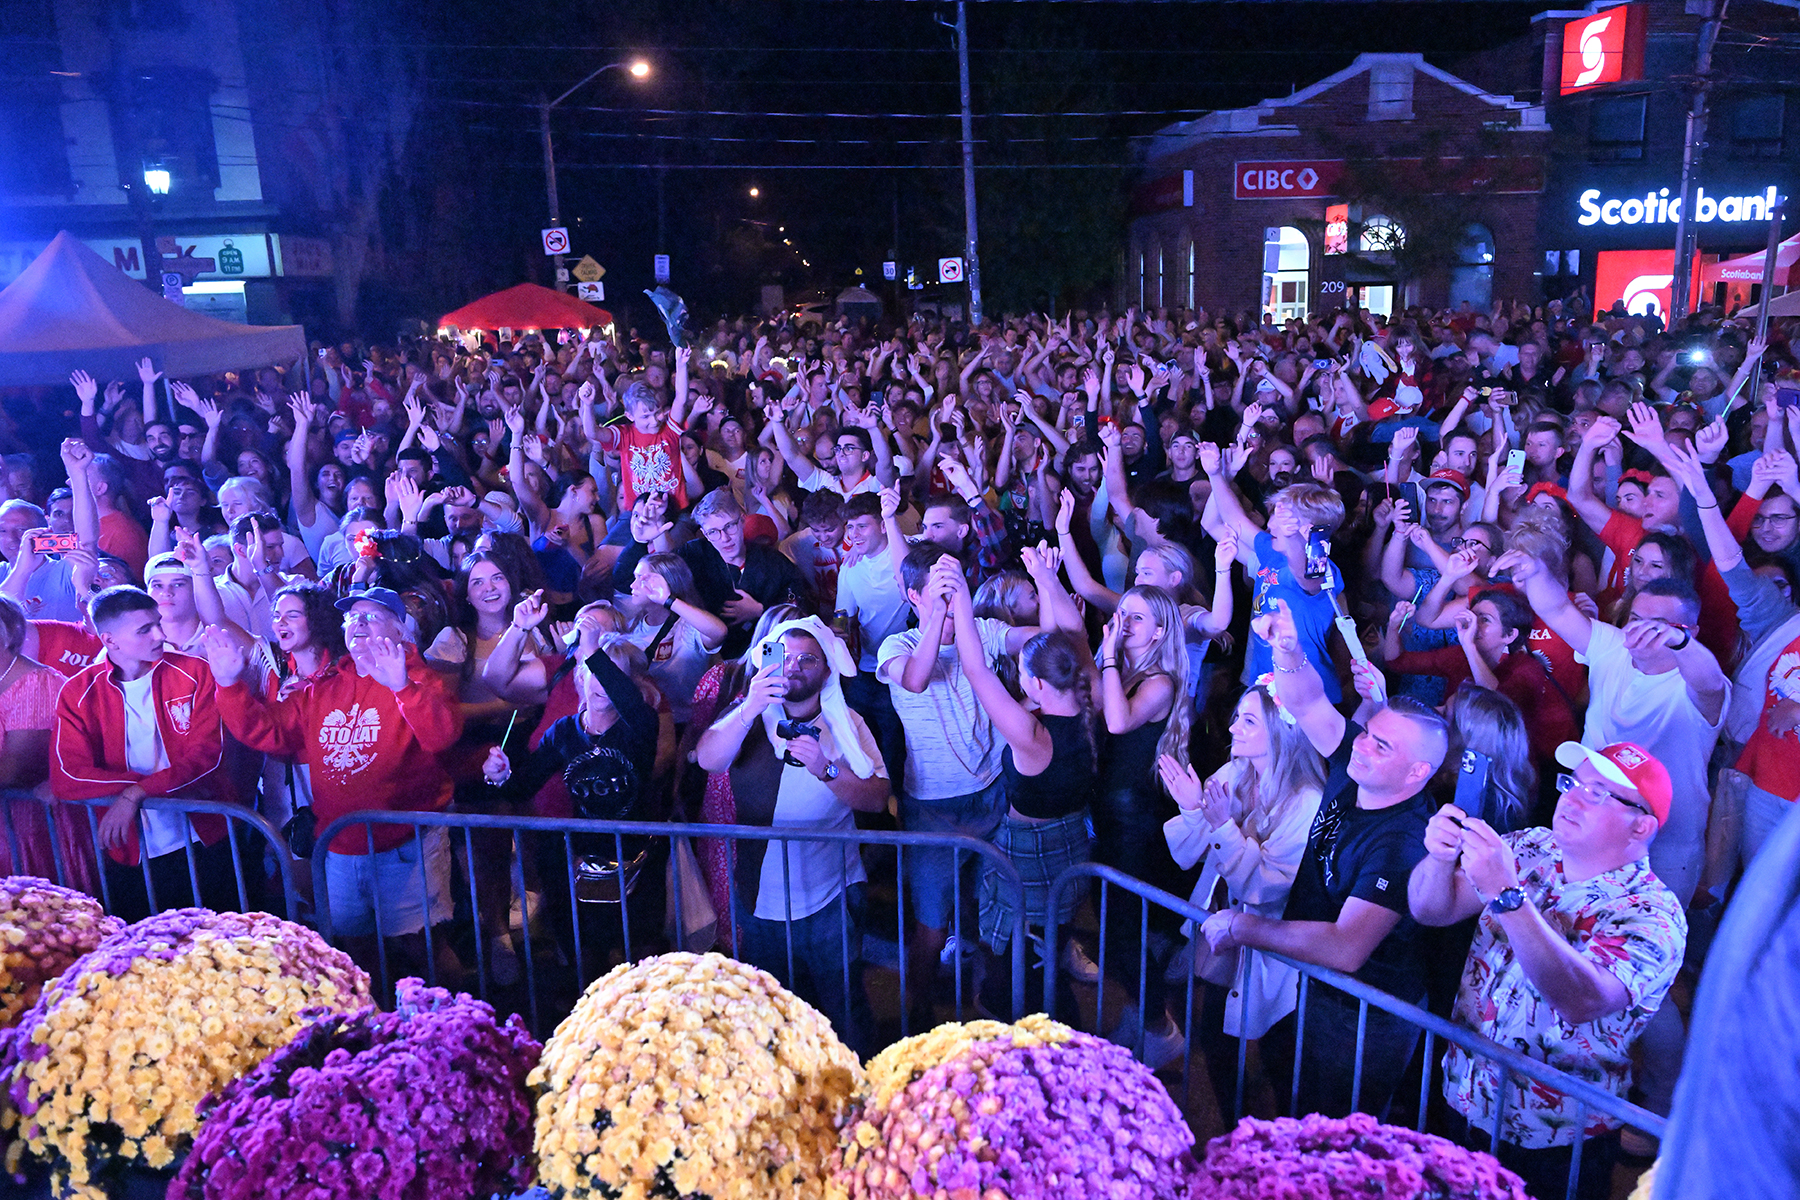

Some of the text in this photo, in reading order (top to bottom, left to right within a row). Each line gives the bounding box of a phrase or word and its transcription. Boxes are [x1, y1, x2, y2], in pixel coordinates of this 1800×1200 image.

[1242, 169, 1295, 190] CIBC
[885, 267, 895, 275] 30
[1320, 280, 1345, 293] 209
[58, 649, 97, 667] POL
[318, 725, 382, 744] STO LAT
